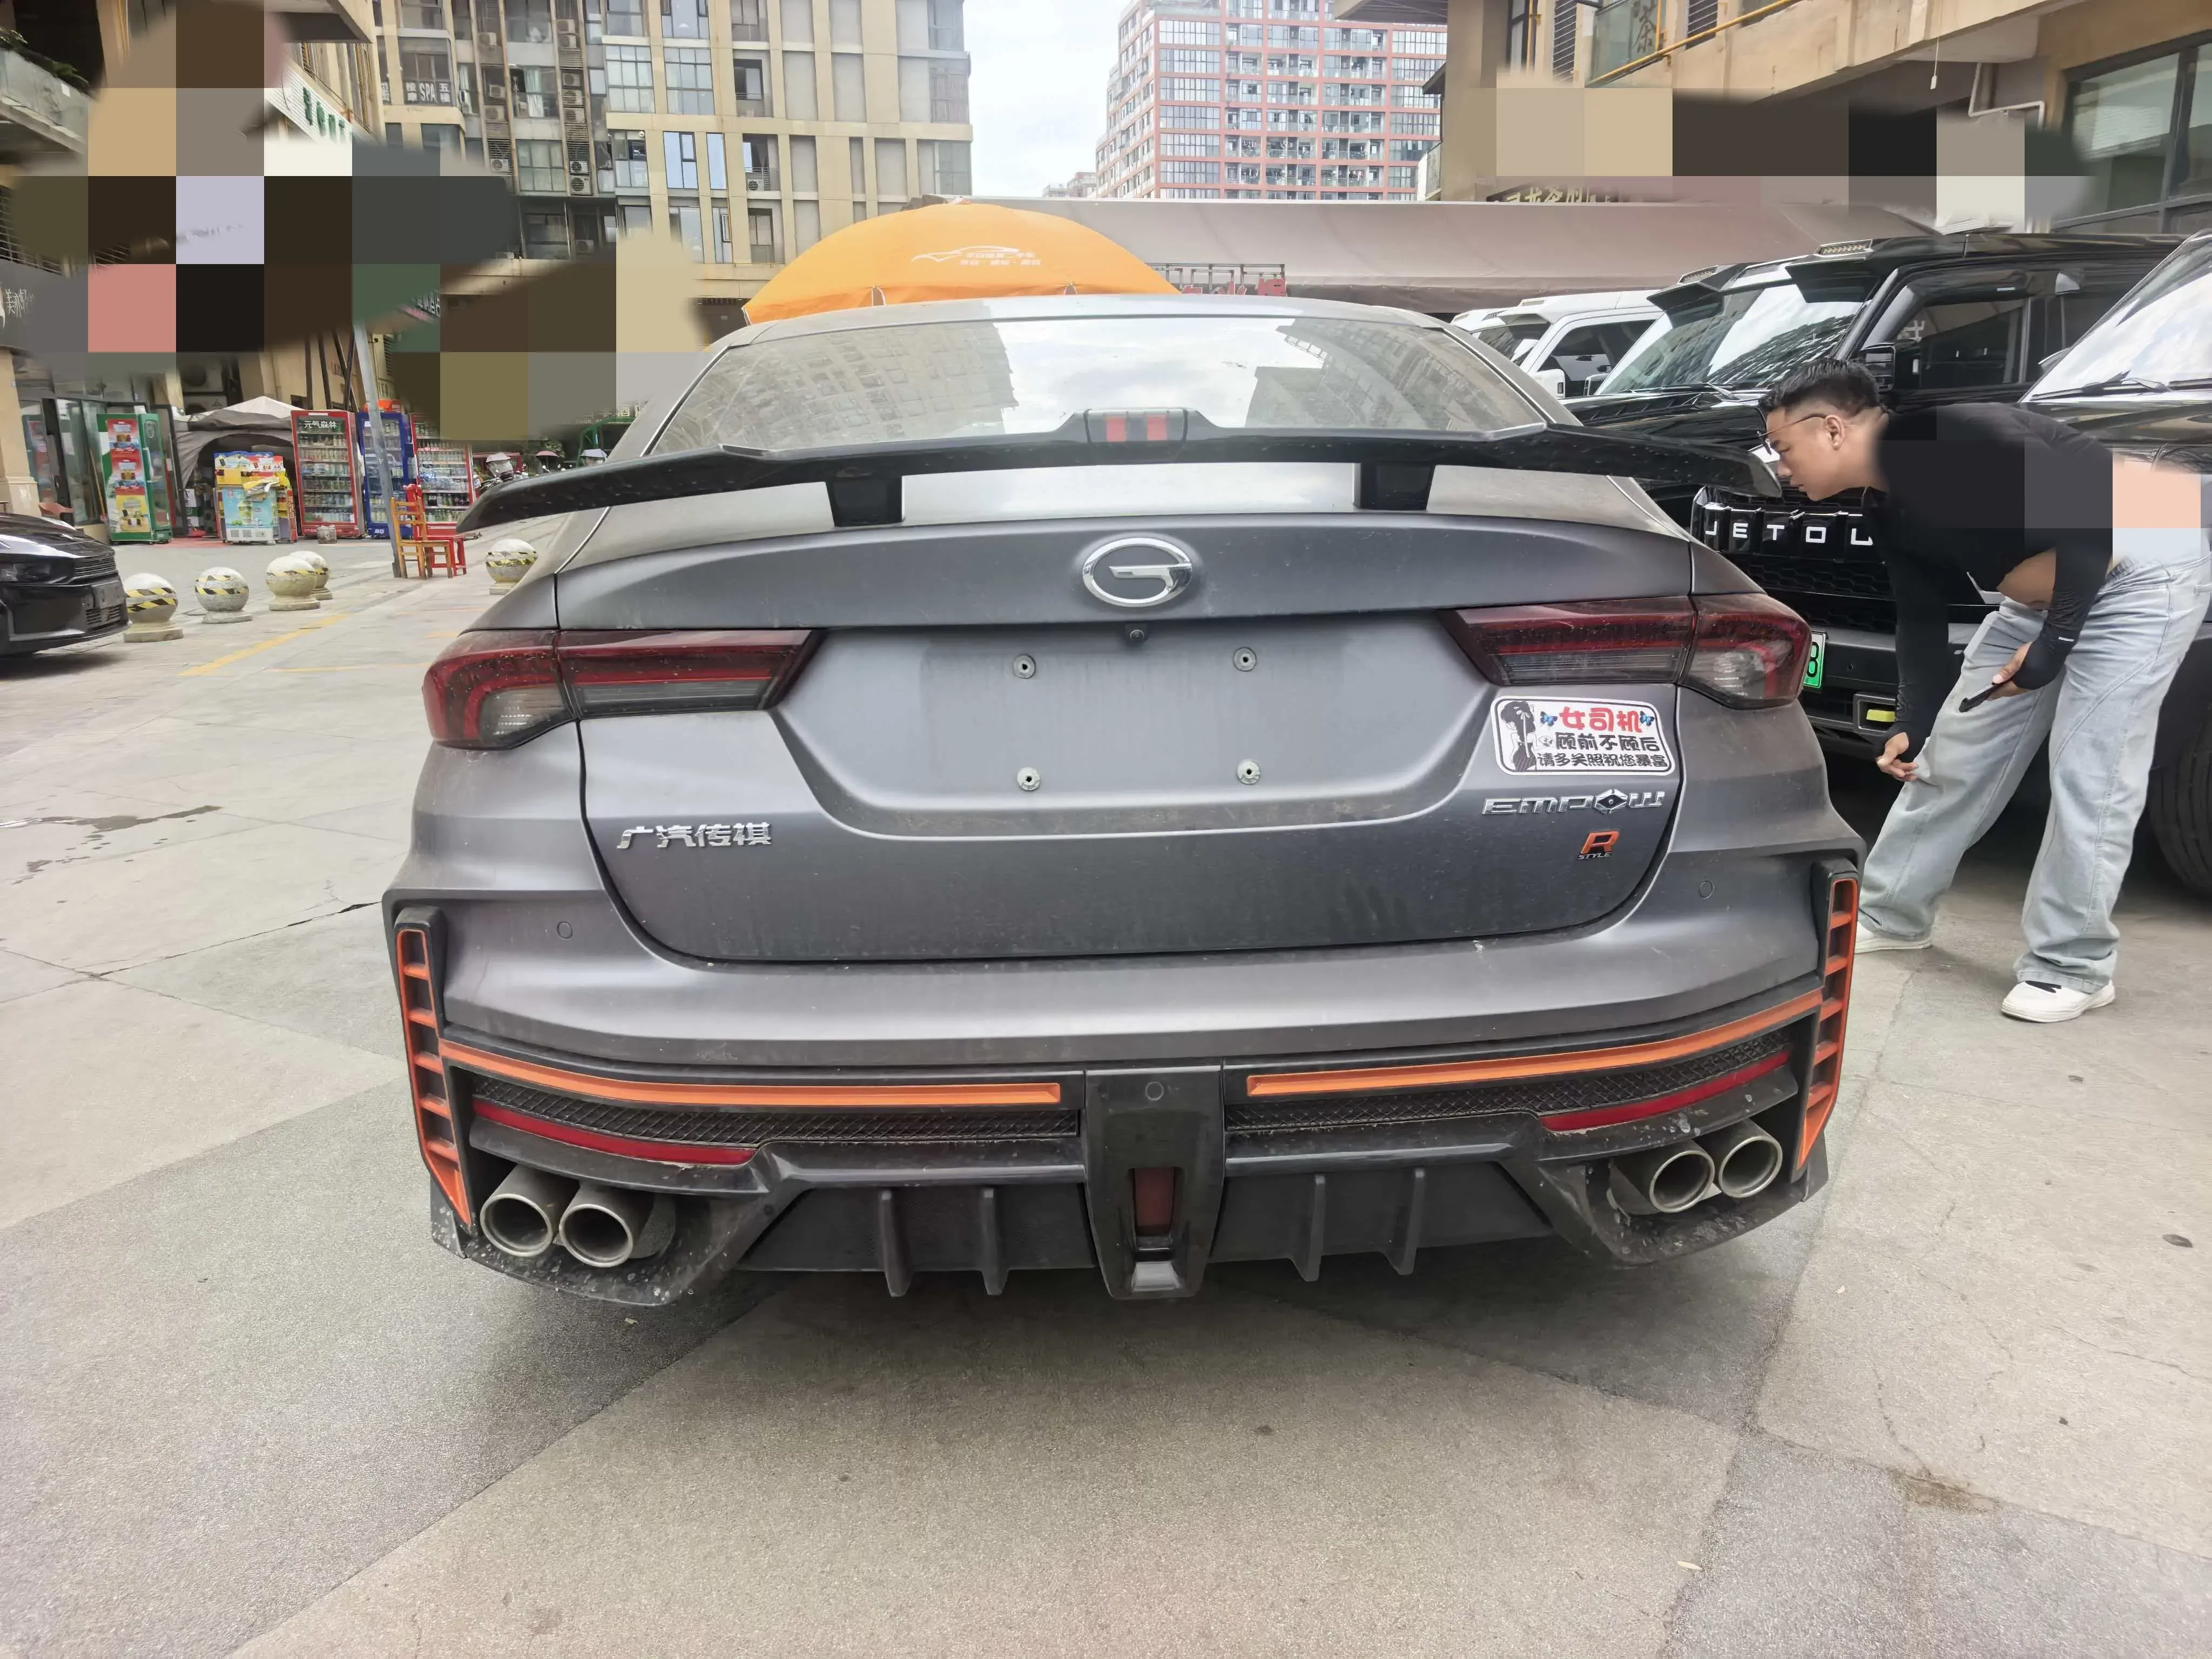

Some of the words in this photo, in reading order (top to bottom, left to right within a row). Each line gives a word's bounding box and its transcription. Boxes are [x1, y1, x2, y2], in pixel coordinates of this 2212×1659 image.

[419, 83, 437, 103] SPA
[304, 421, 338, 429] 元气森林
[1705, 521, 1873, 546] JETOU
[1559, 706, 1642, 733] 女司机
[1555, 732, 1660, 752] 顾前不顾后
[1537, 752, 1668, 767] 请多关照祝您暴富
[1482, 787, 1665, 815] EMPOW
[617, 821, 772, 849] 广汽传祺
[1581, 831, 1620, 855] R
[1577, 852, 1613, 860] STYLE
